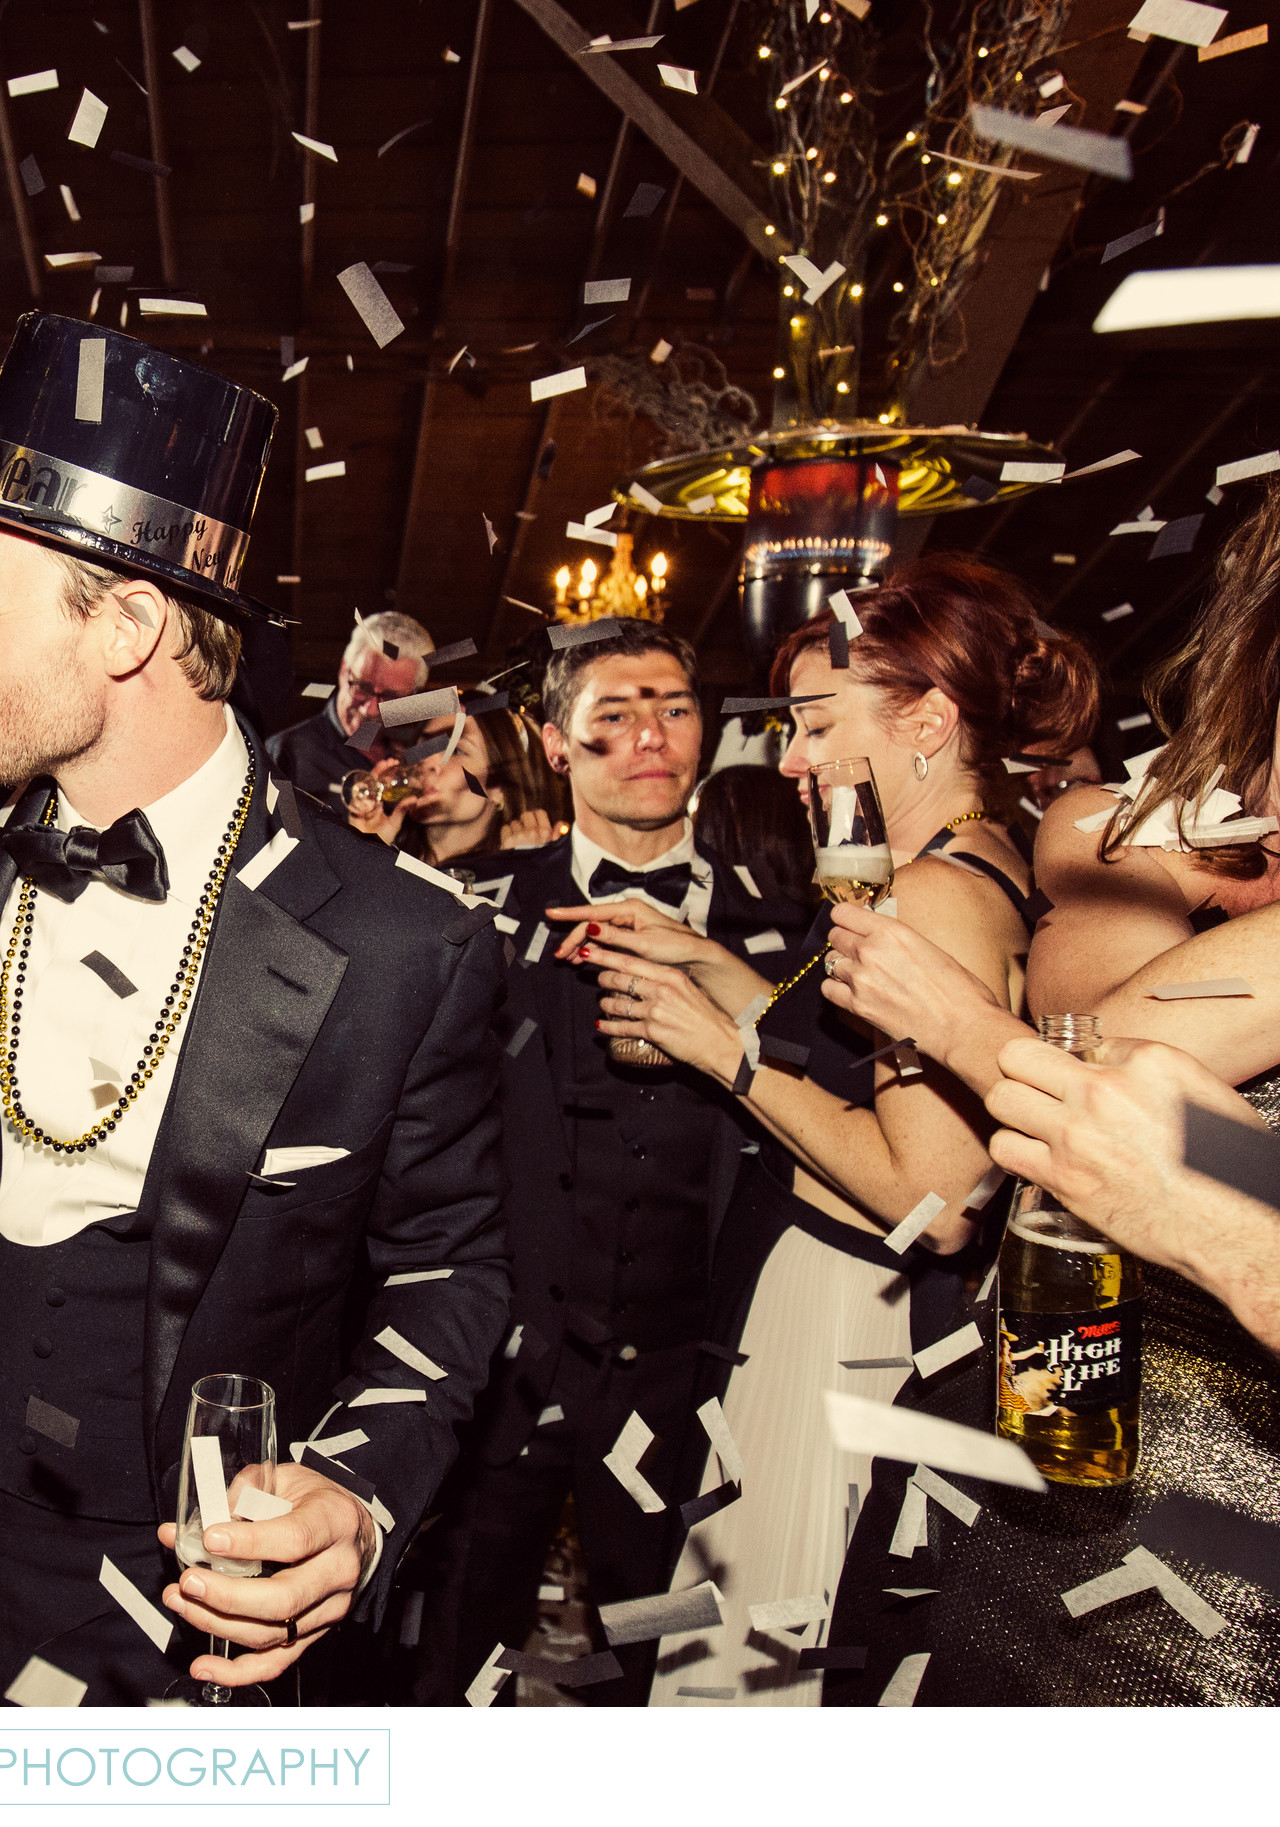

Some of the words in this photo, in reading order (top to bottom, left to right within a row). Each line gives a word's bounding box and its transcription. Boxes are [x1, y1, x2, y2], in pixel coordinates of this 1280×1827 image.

[130, 519, 208, 545] Happy
[191, 548, 225, 572] New
[1043, 1328, 1122, 1372] HIGH
[1060, 1358, 1121, 1398] LIFE
